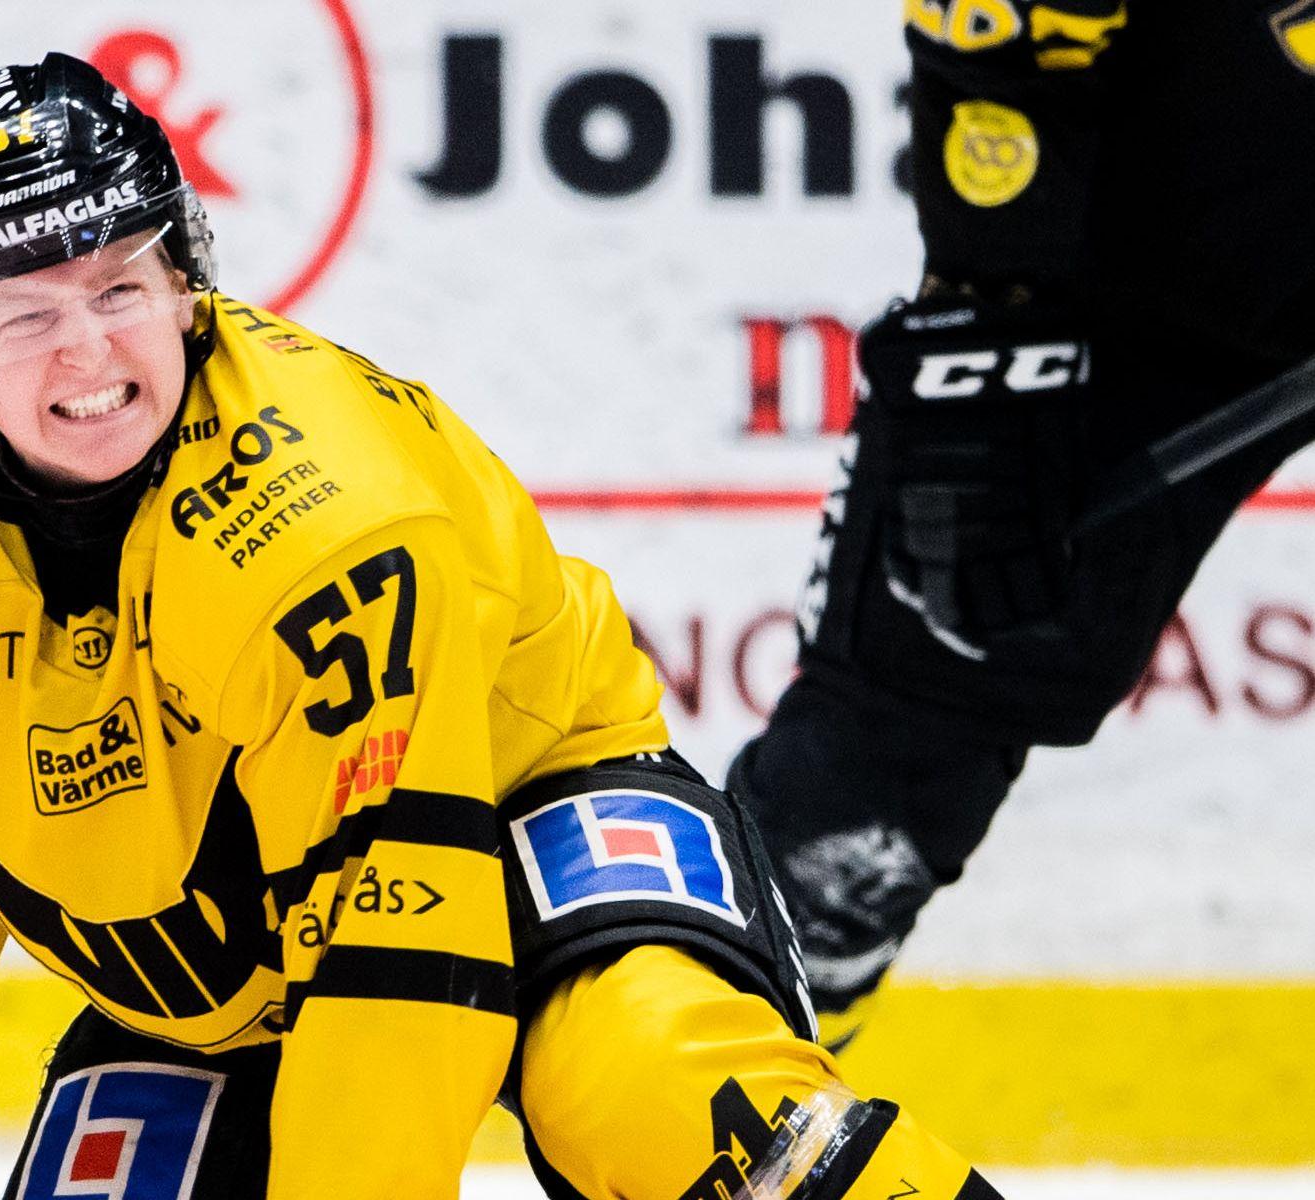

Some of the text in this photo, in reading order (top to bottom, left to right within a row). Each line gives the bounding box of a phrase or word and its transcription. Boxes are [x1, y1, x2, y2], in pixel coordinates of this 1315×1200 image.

[412, 32, 916, 198] Joh
[912, 342, 1092, 400] CC
[170, 405, 305, 540] AROS
[212, 460, 322, 550] INDUSTRI
[229, 480, 343, 570] PARTNER
[273, 545, 417, 738] 57
[35, 742, 97, 777] Bad
[98, 713, 137, 756] &
[40, 755, 144, 806] Värme
